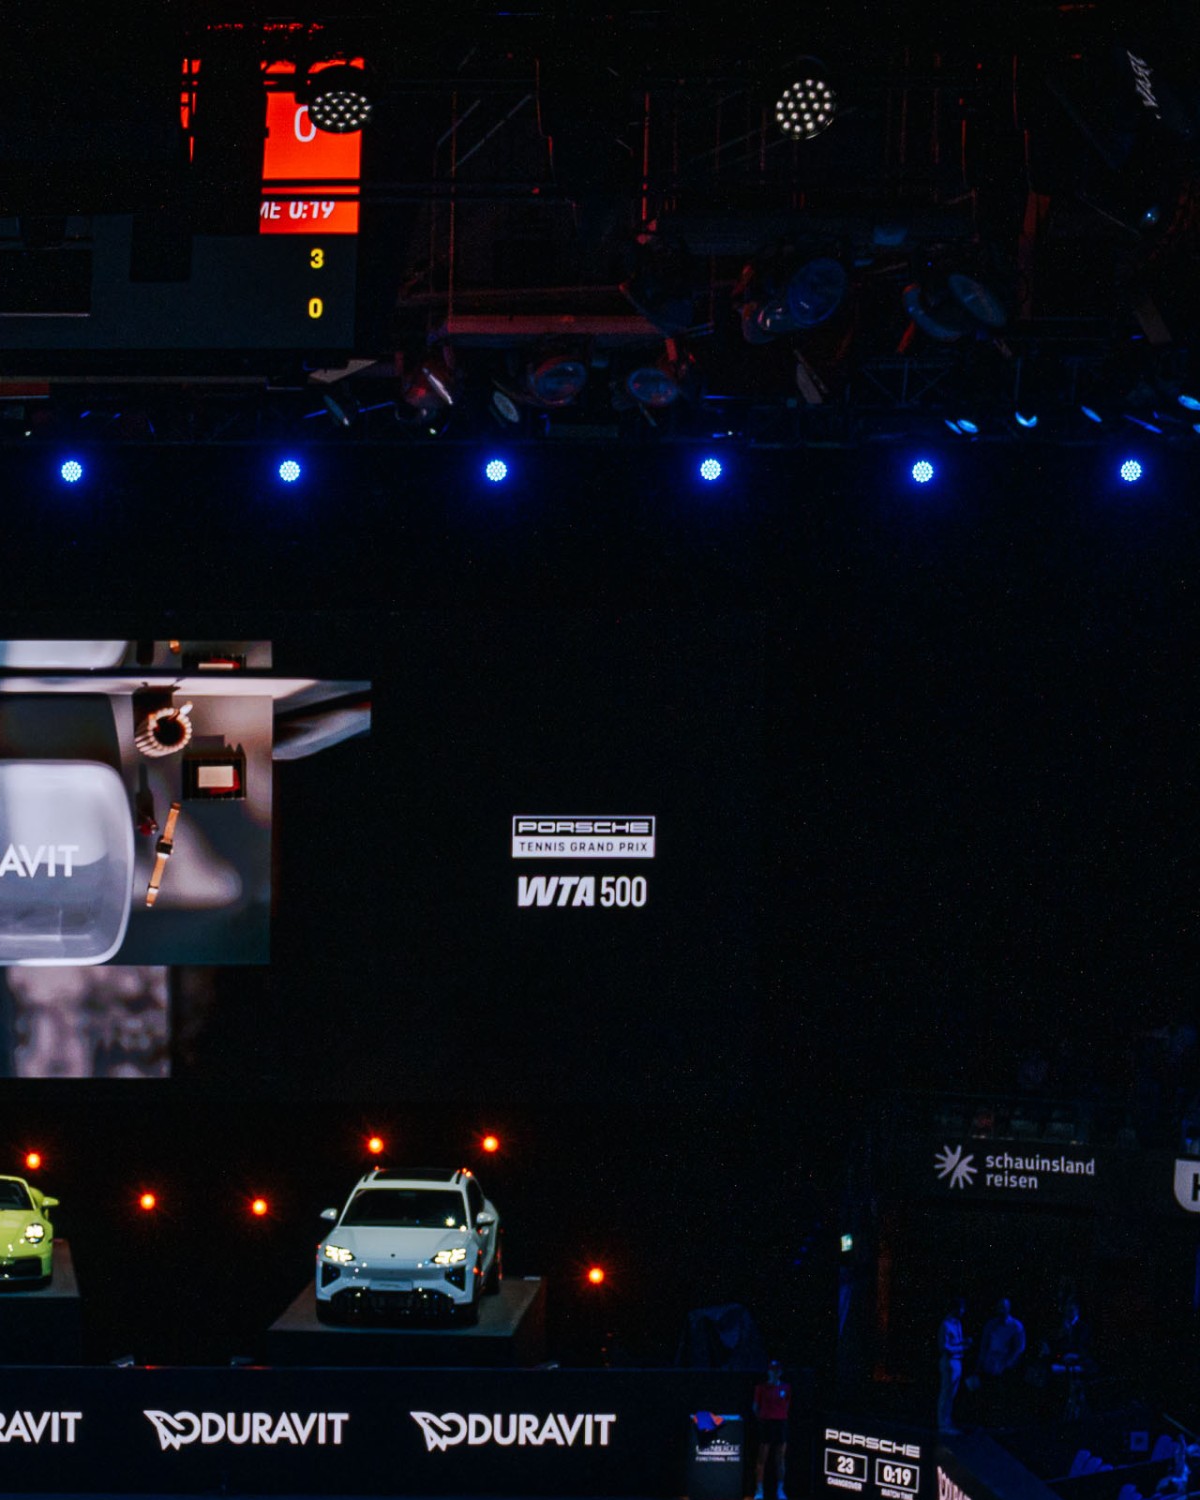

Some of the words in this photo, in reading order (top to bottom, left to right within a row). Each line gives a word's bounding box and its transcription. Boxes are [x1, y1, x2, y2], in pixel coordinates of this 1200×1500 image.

[289, 201, 335, 219] 0:19
[310, 248, 325, 269] 3
[308, 297, 323, 319] 0
[518, 821, 650, 834] PORSCHE
[519, 841, 565, 852] TENNIS
[570, 842, 614, 852] GRAND
[619, 842, 648, 852] PRIX
[517, 875, 596, 907] WTA
[600, 875, 647, 907] 500
[985, 1152, 1096, 1176] schauinsland
[985, 1172, 1039, 1189] reisen
[201, 1411, 350, 1445] DURAVIT
[467, 1412, 617, 1446] DURAVIT
[825, 1428, 920, 1459] PORSCHE
[836, 1455, 855, 1475] 23
[883, 1465, 912, 1486] 0:19
